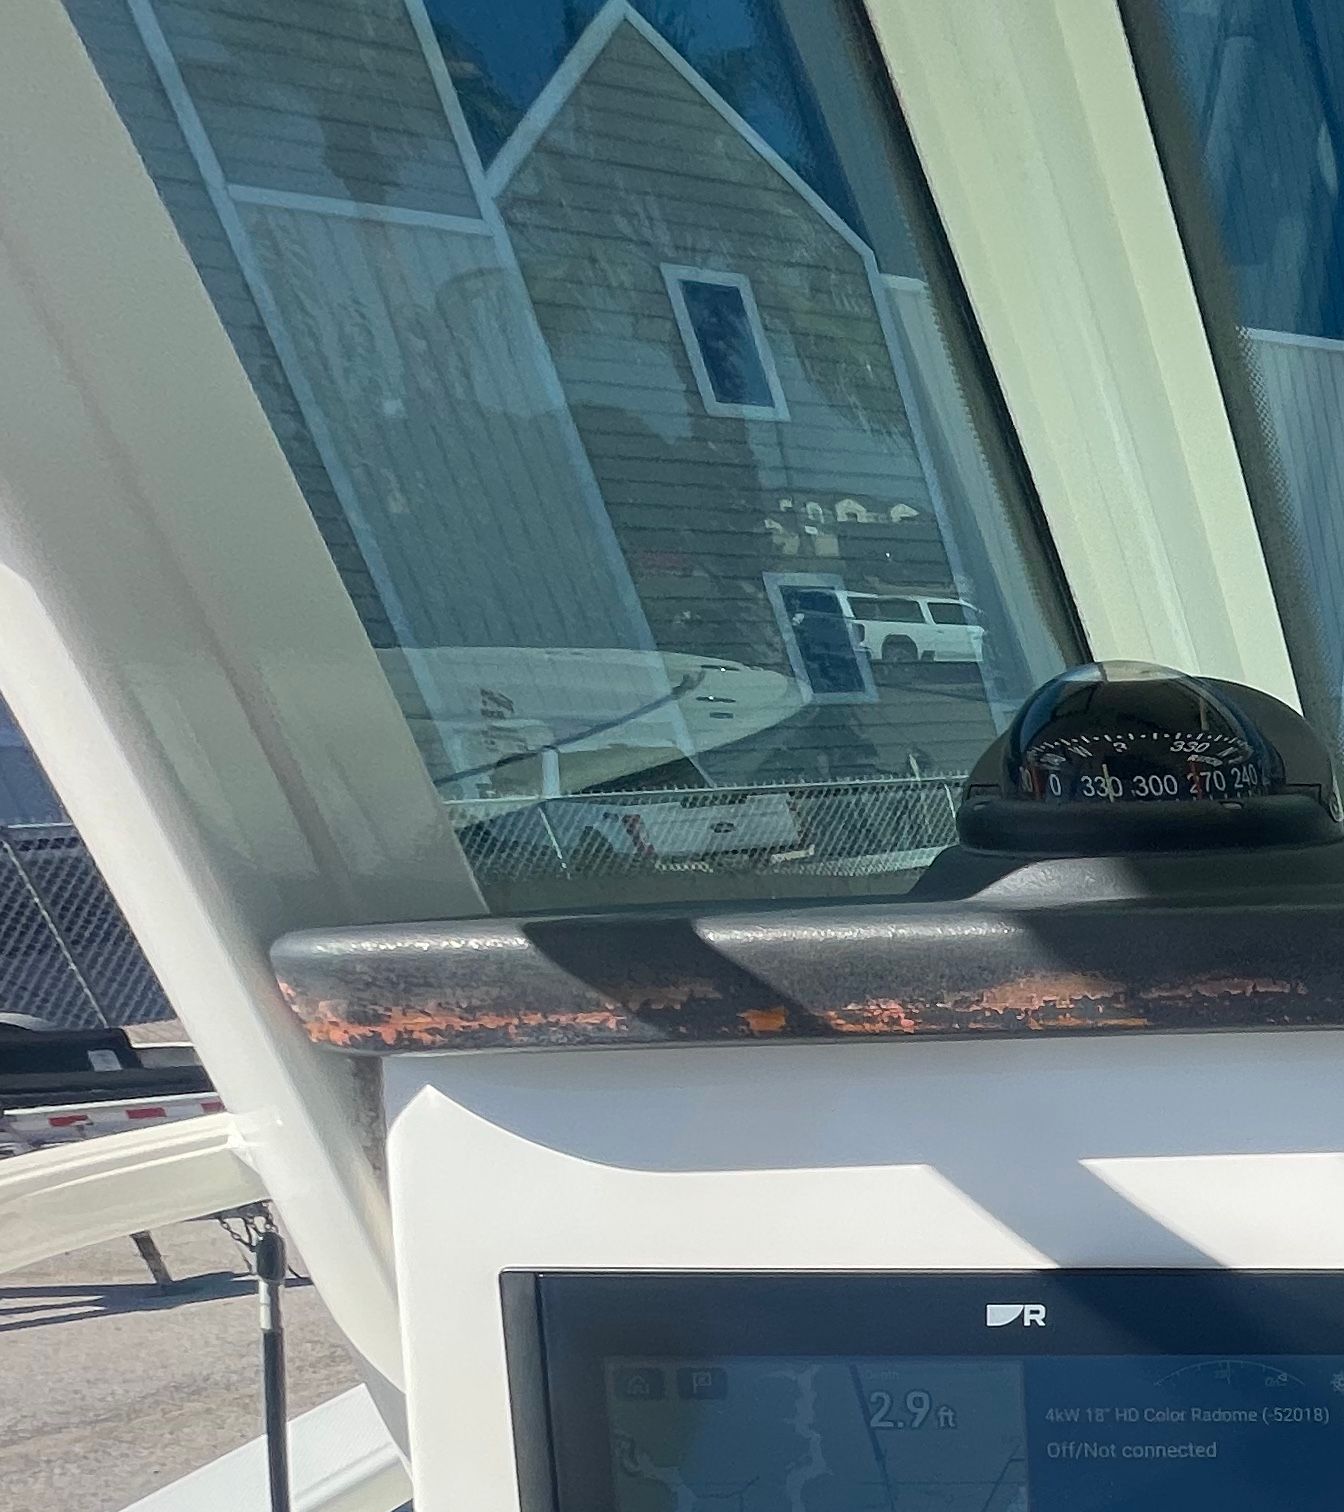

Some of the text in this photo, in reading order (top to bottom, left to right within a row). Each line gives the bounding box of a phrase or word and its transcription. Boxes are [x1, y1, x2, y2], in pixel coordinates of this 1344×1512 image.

[1081, 776, 1123, 797] 330
[1133, 775, 1178, 796] 300
[868, 1390, 956, 1429] 2.9 ft
[1046, 1408, 1079, 1422] 4kW
[1115, 1408, 1140, 1422] HD
[1144, 1407, 1185, 1422] Color
[1191, 1407, 1257, 1423] Radome
[1047, 1442, 1217, 1460] Off/Not connected
